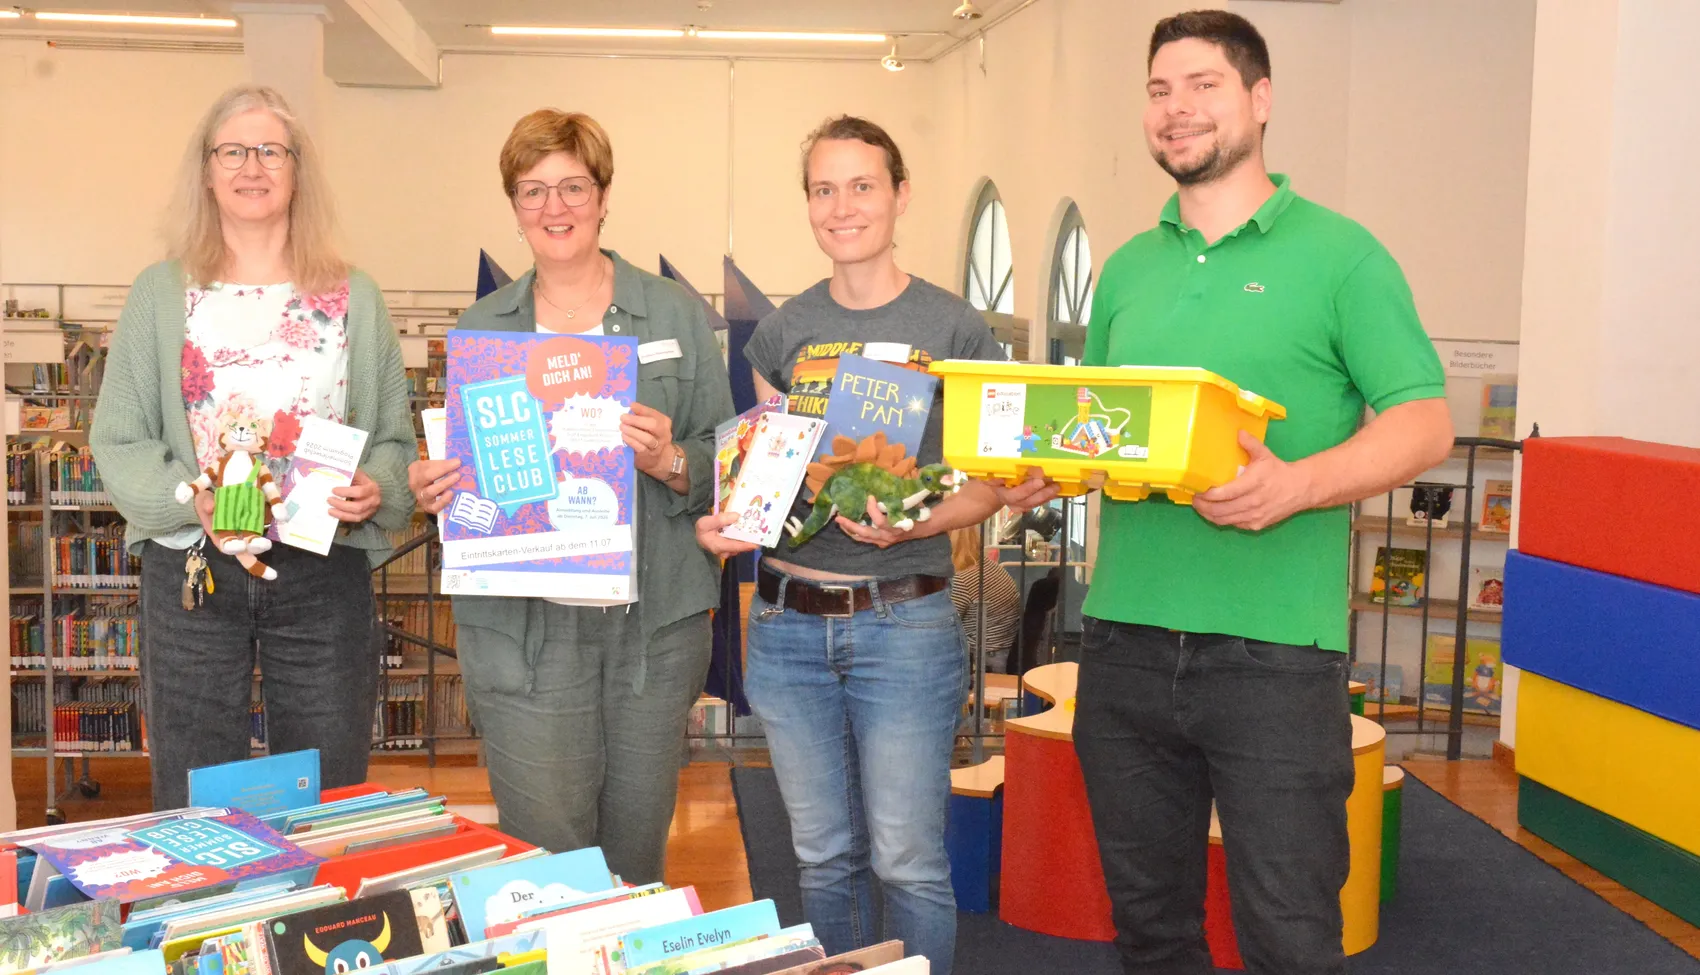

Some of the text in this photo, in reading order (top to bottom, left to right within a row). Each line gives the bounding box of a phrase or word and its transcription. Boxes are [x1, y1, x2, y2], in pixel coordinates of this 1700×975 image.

[807, 341, 863, 359] MIDDLE
[1453, 349, 1494, 359] Besondere
[1449, 361, 1496, 370] Bilderbücher
[542, 365, 593, 387] DICH AN!
[840, 372, 899, 404] PETER
[476, 390, 531, 429] SLC
[580, 408, 603, 419] WO?
[860, 400, 904, 428] PAN
[484, 428, 535, 448] SOMMER
[488, 444, 540, 471] LESE
[983, 445, 993, 453] 6+
[493, 468, 543, 494] CLUB
[577, 485, 588, 495] AB
[568, 496, 597, 506] WANN?
[461, 544, 553, 561] Eintrittskarten-Verkauf
[555, 542, 566, 551] ab
[568, 540, 587, 550] dem
[146, 821, 202, 839] CLUB
[162, 827, 221, 847] LESE
[180, 834, 233, 853] SOMMER
[195, 841, 261, 866] SLC
[114, 868, 142, 878] WO?
[511, 890, 534, 905] Der
[315, 914, 377, 935] EDOUARD MANCEAU
[662, 935, 695, 954] Eselin
[699, 927, 731, 946] Evelyn
